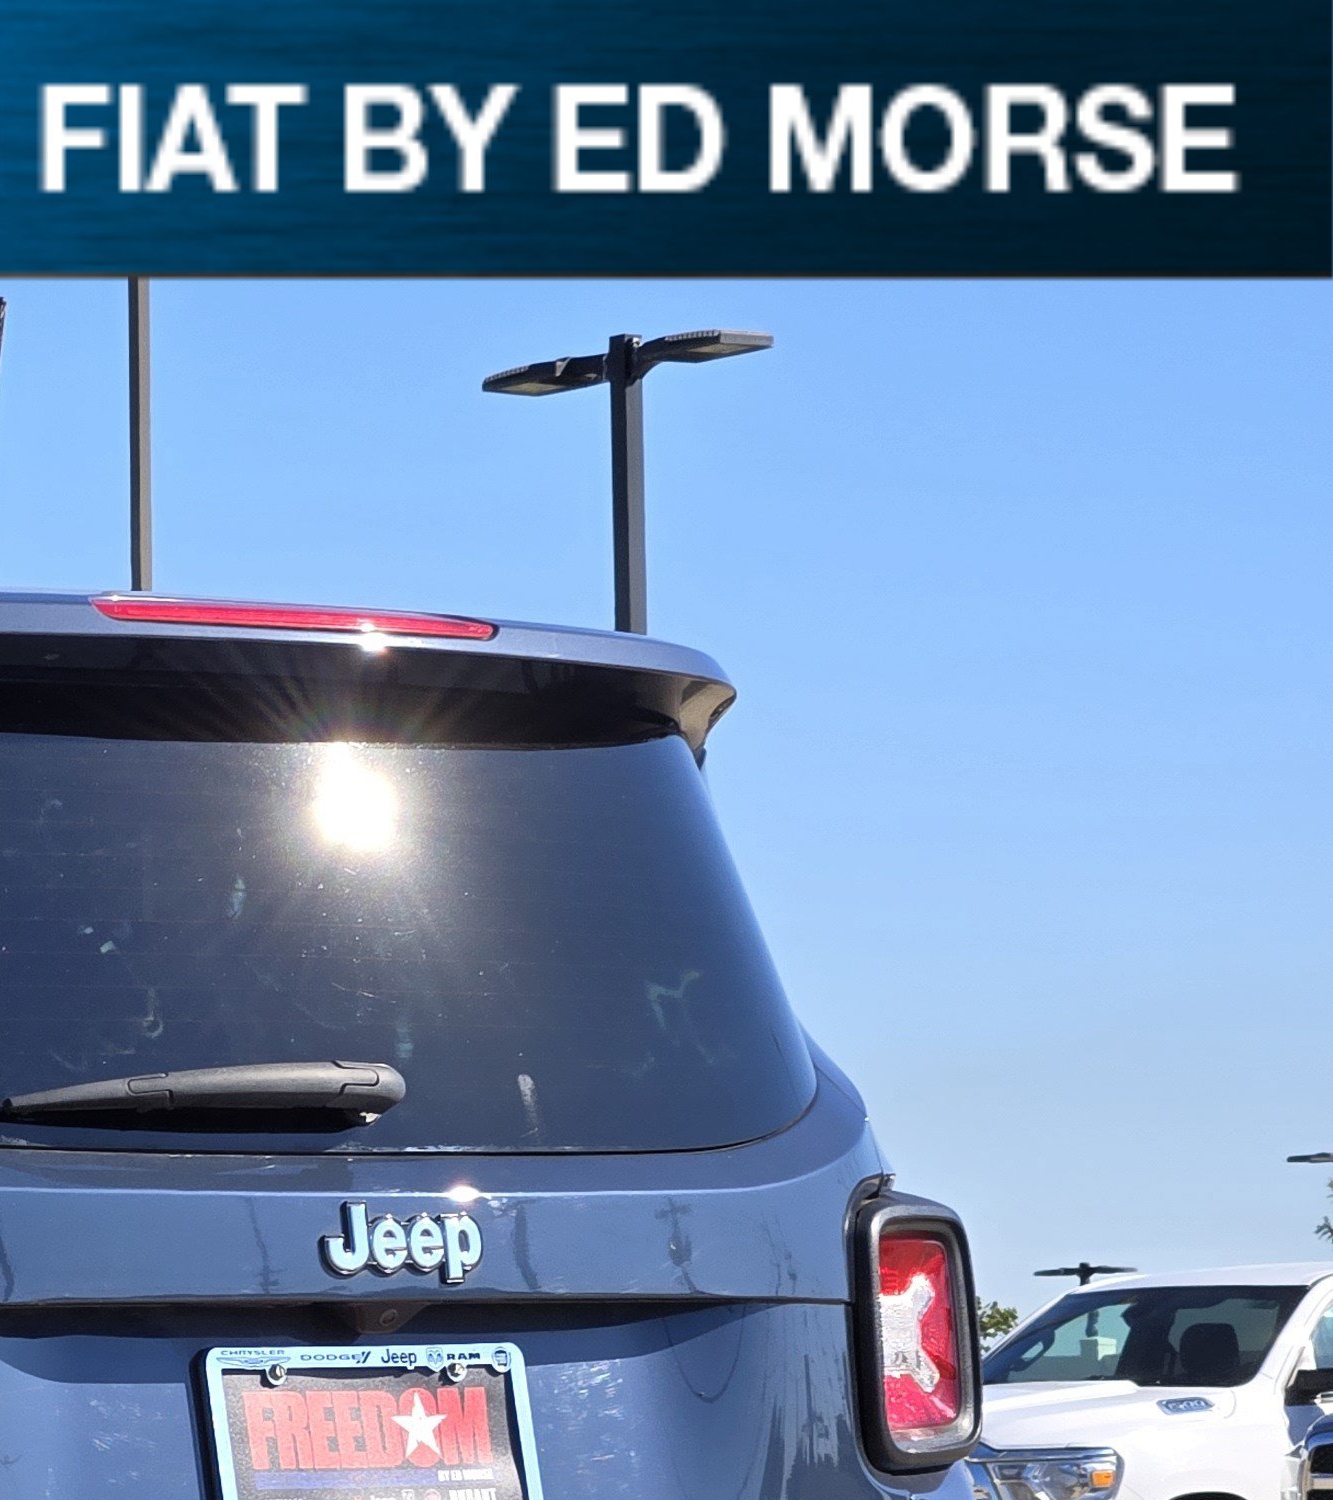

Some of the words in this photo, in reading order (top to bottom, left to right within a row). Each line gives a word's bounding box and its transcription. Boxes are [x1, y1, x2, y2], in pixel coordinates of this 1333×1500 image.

[318, 1200, 482, 1285] Jeep
[381, 1349, 417, 1366] Jeep
[446, 1352, 481, 1361] RAM
[242, 1386, 493, 1470] FREEDOM
